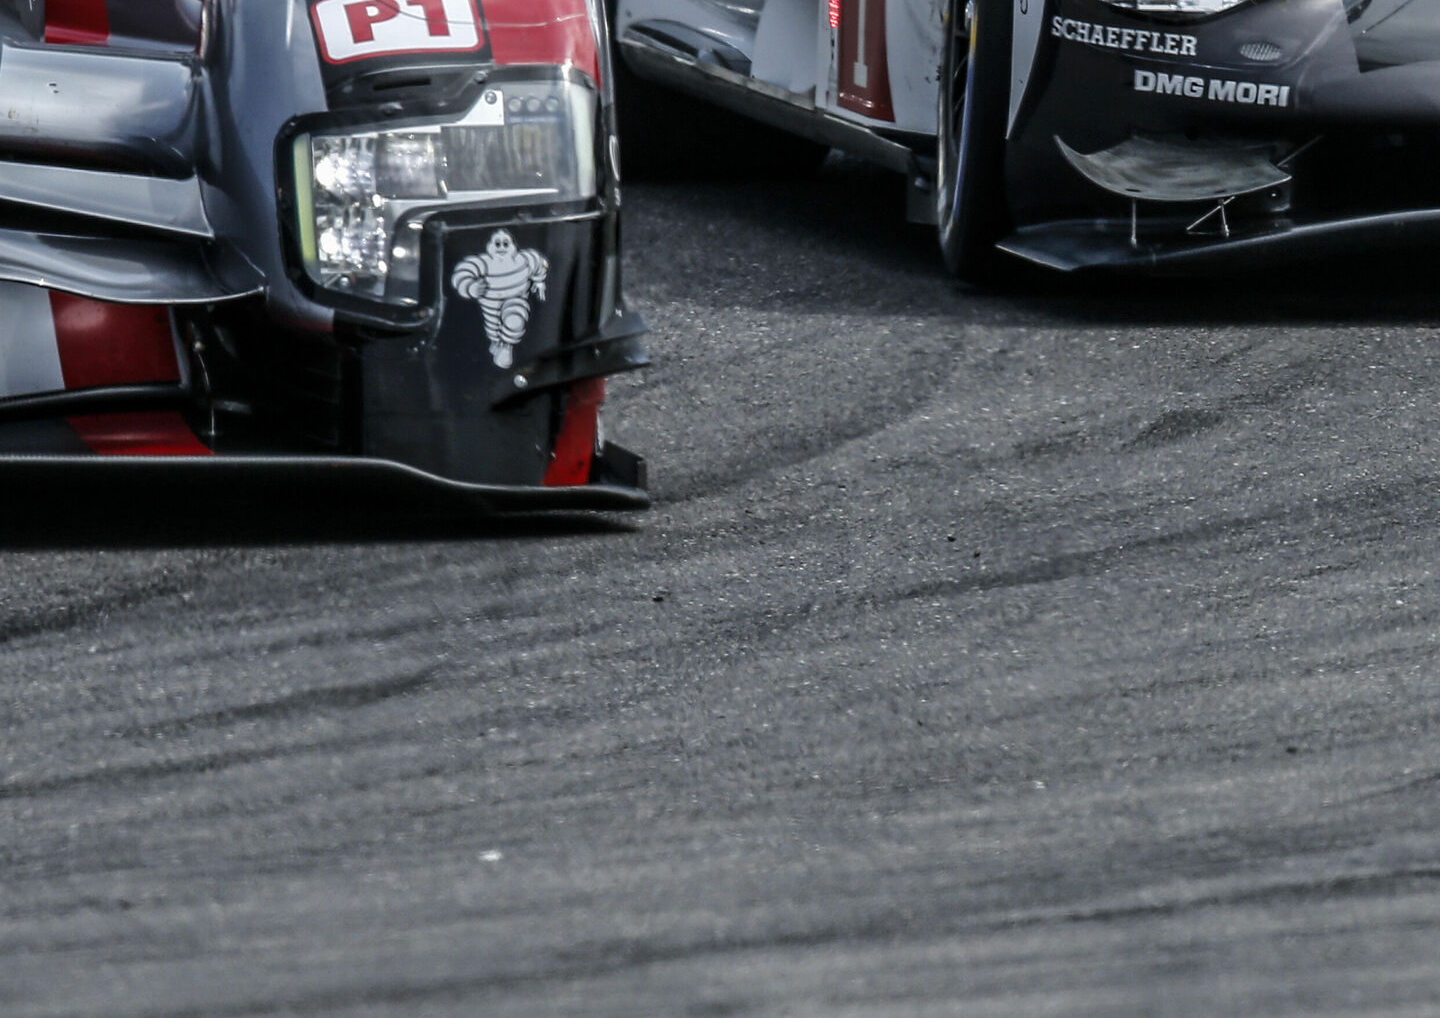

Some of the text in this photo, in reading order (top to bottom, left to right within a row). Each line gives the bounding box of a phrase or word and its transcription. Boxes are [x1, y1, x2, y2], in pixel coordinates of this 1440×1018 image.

[1051, 16, 1198, 56] SCHAEFFLER
[1133, 69, 1291, 107] DMG MORI
